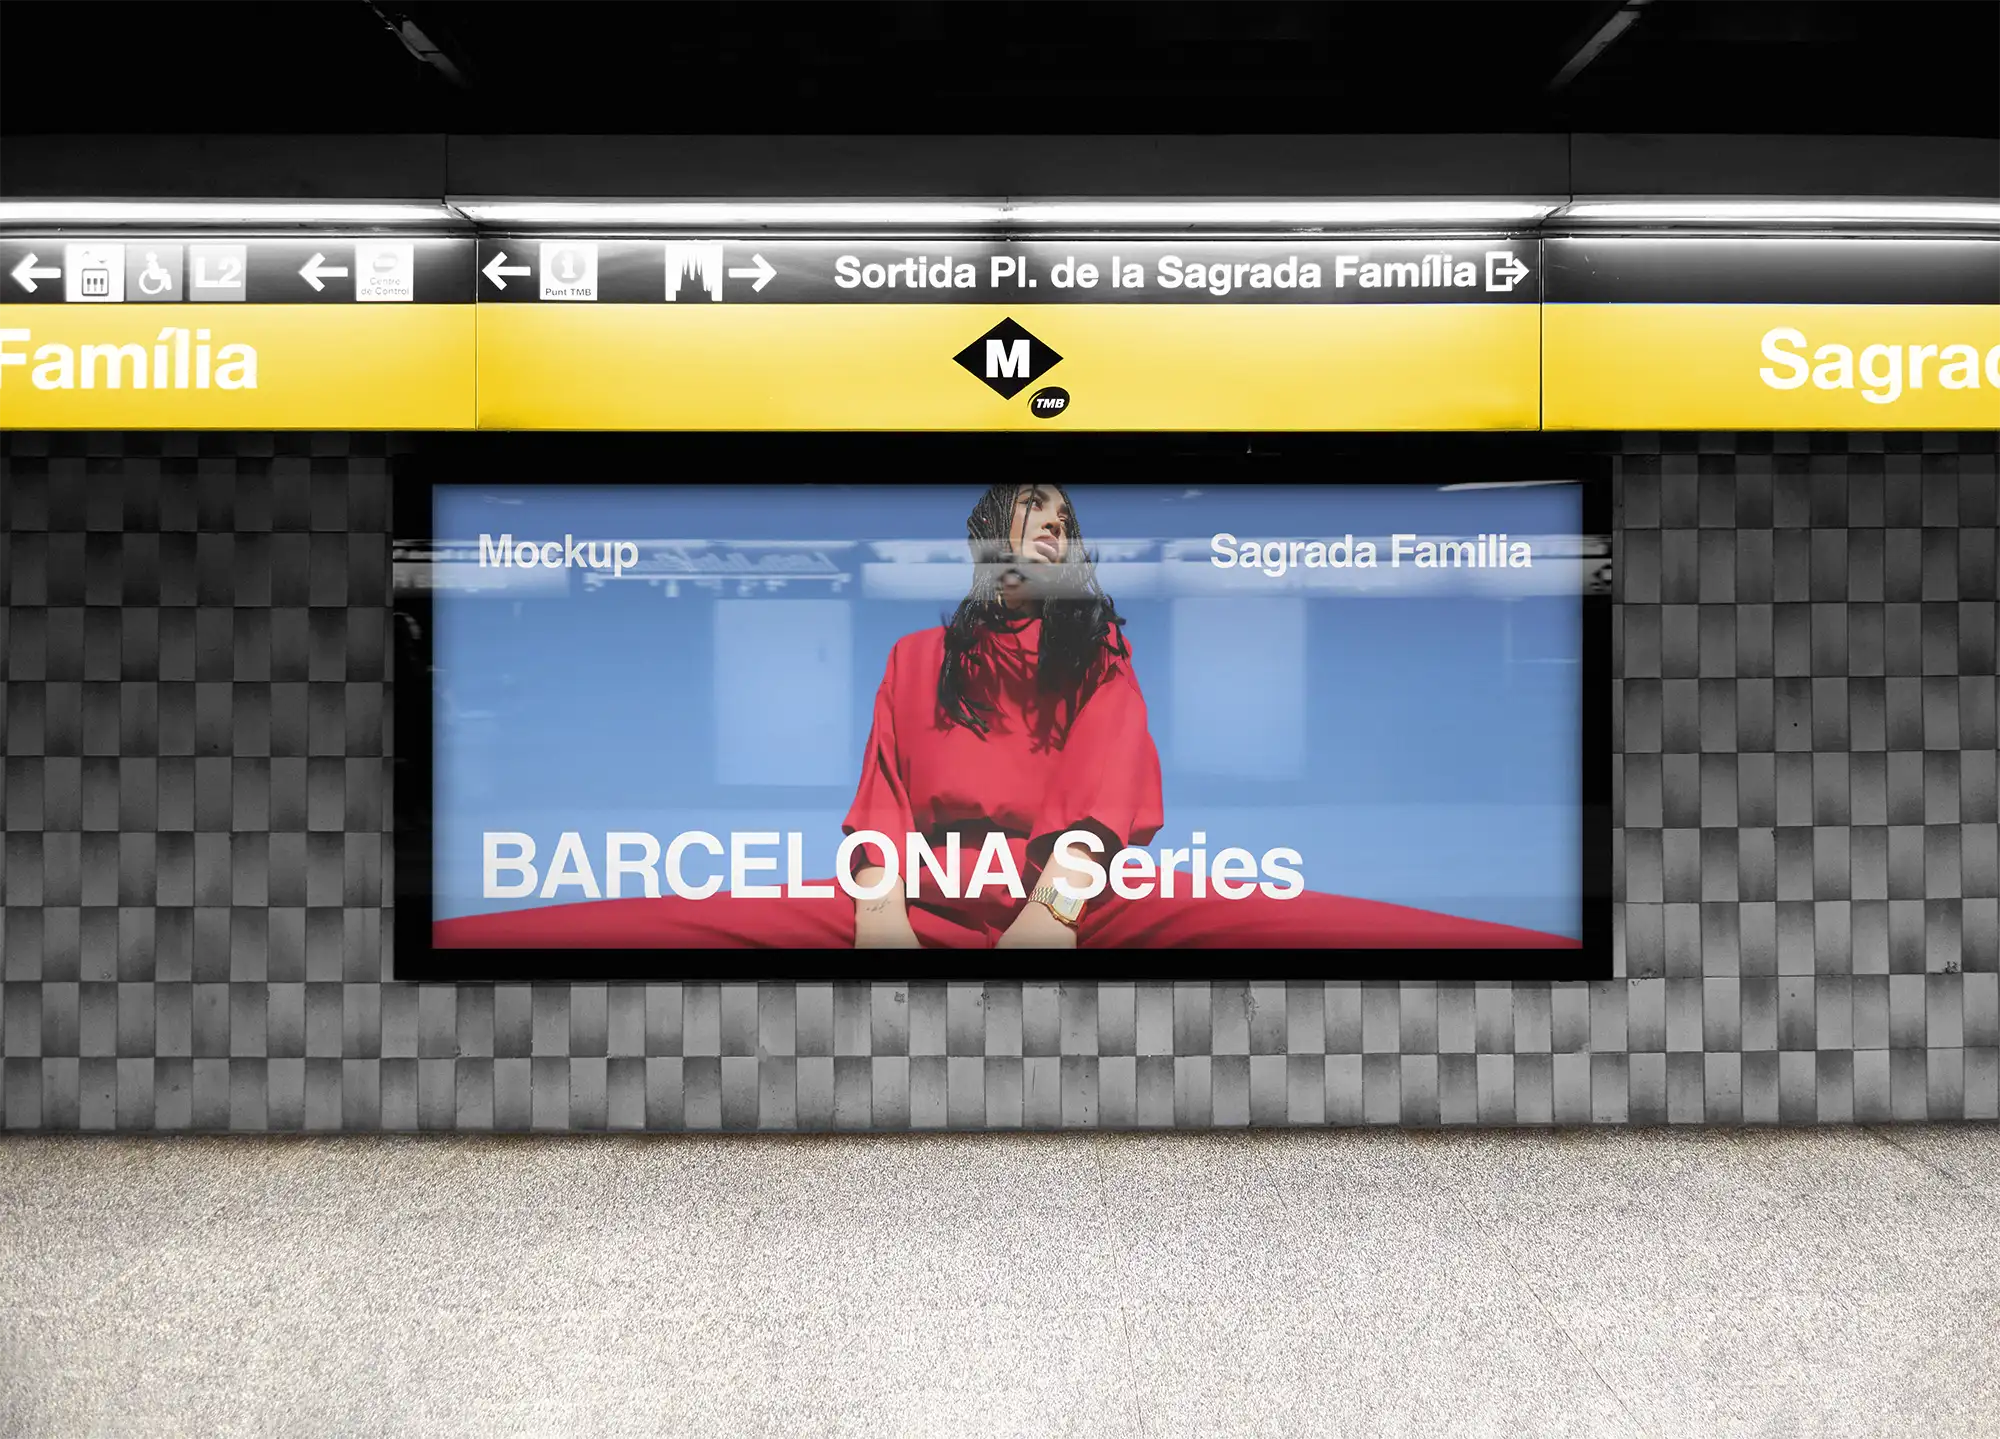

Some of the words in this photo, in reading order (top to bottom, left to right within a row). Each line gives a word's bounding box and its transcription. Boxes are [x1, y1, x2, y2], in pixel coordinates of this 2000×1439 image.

[195, 256, 242, 288] L2
[361, 287, 372, 296] de
[374, 287, 410, 296] Control
[370, 277, 401, 286] Centre
[834, 255, 976, 289] Sortida
[990, 256, 1037, 288] Pl.
[1050, 256, 1099, 288] de
[1112, 256, 1144, 288] la
[1157, 255, 1321, 296] Sagrada
[1335, 252, 1477, 288] Família
[545, 288, 567, 297] Punt
[570, 288, 592, 297] TMB
[0, 326, 258, 391] Família
[986, 339, 1030, 378] M
[1036, 398, 1065, 409] TMB
[478, 533, 639, 577] Mockup
[1210, 532, 1377, 578] Sagrada
[1391, 533, 1533, 569] Familia
[482, 830, 1026, 901] BARCELONA
[1052, 830, 1305, 900] Series
